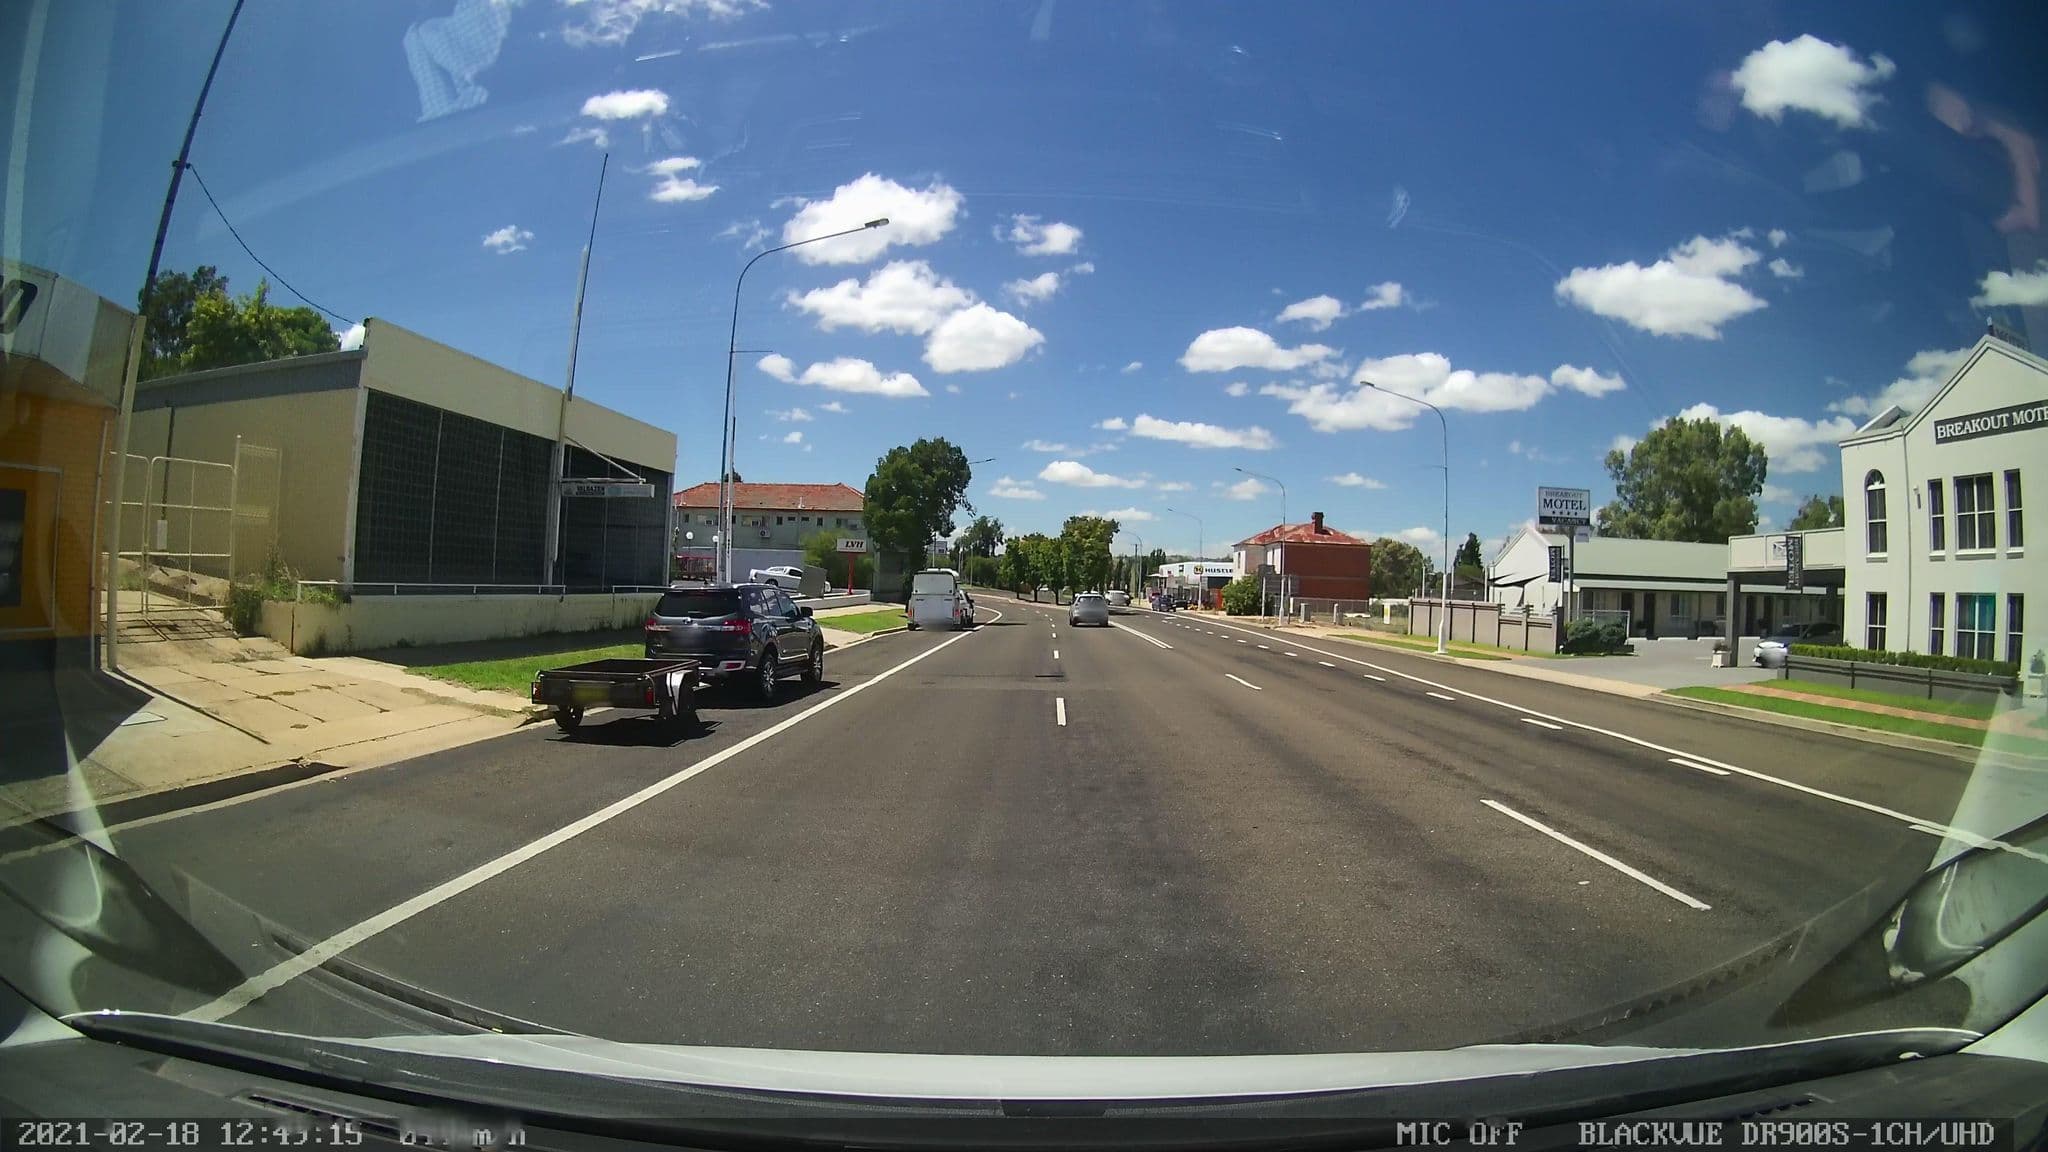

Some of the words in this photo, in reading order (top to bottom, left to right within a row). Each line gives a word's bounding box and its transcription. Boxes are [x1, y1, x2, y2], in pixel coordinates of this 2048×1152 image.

[1936, 413, 2010, 439] BREAKOUT
[1543, 498, 1587, 511] MOTEL
[1551, 516, 1587, 525] VACANCY
